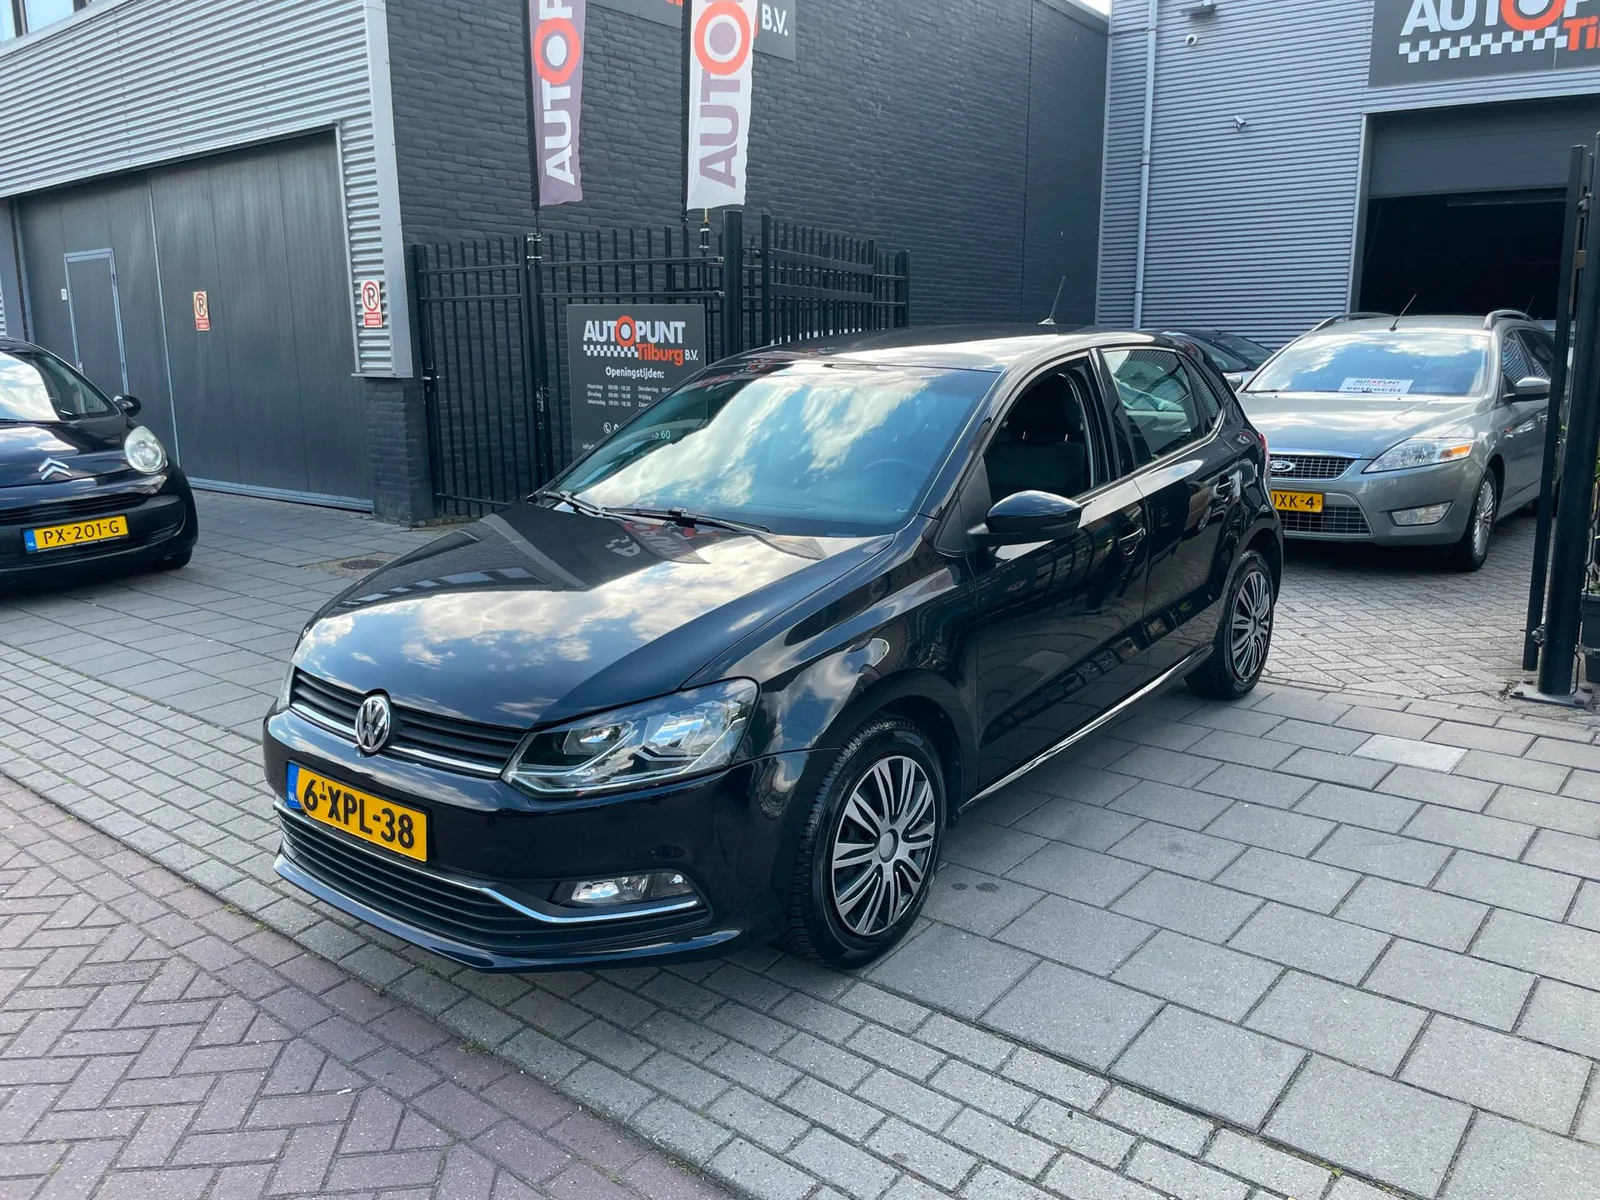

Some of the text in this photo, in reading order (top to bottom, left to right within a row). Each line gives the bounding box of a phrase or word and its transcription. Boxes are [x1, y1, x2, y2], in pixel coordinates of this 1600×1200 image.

[761, 3, 789, 37] B.V.
[1562, 16, 1600, 51] Ti
[694, 0, 750, 189] AUTO
[583, 315, 686, 347] AUTOPUNT
[636, 343, 699, 366] Tilburg B.V.
[605, 366, 665, 380] Openingstijden:
[43, 520, 120, 544] PX-201-G
[304, 779, 414, 849] 6-XPL-38
